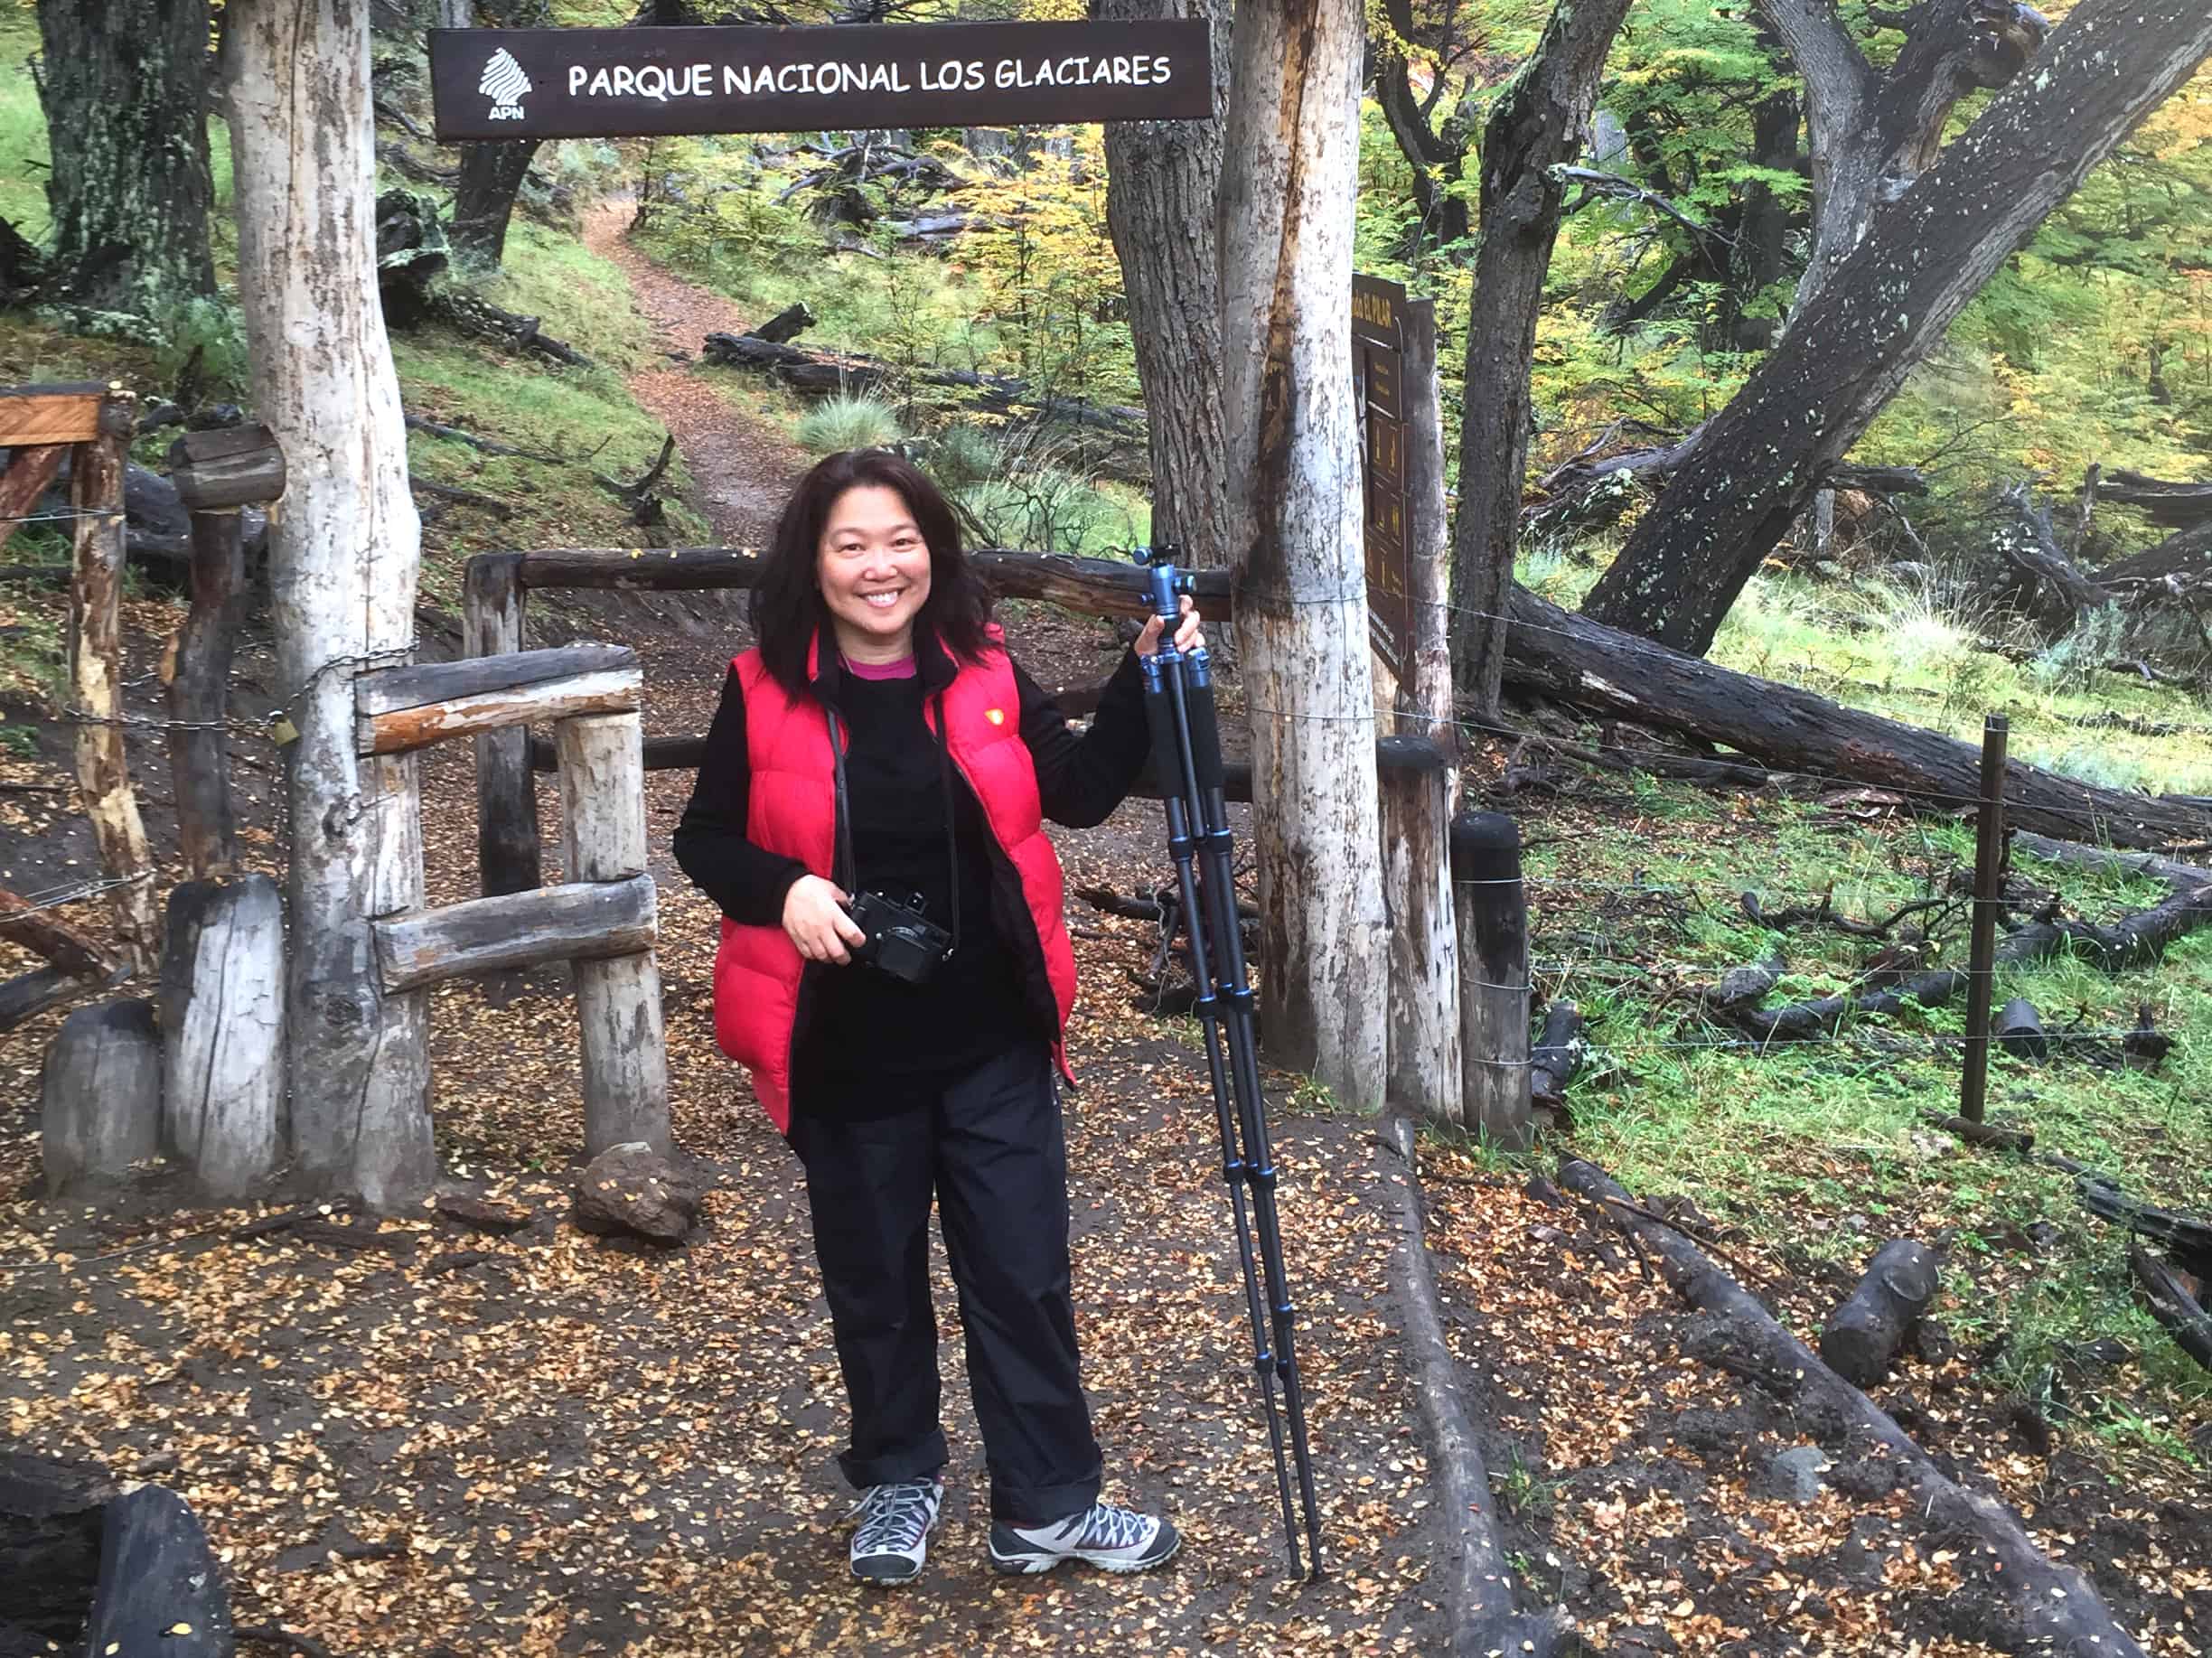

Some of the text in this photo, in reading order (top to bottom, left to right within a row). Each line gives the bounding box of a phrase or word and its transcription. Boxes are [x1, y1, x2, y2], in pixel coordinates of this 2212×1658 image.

[568, 55, 1171, 102] PARQUE NACIONAL LOS GLACIARES
[488, 106, 524, 120] APN
